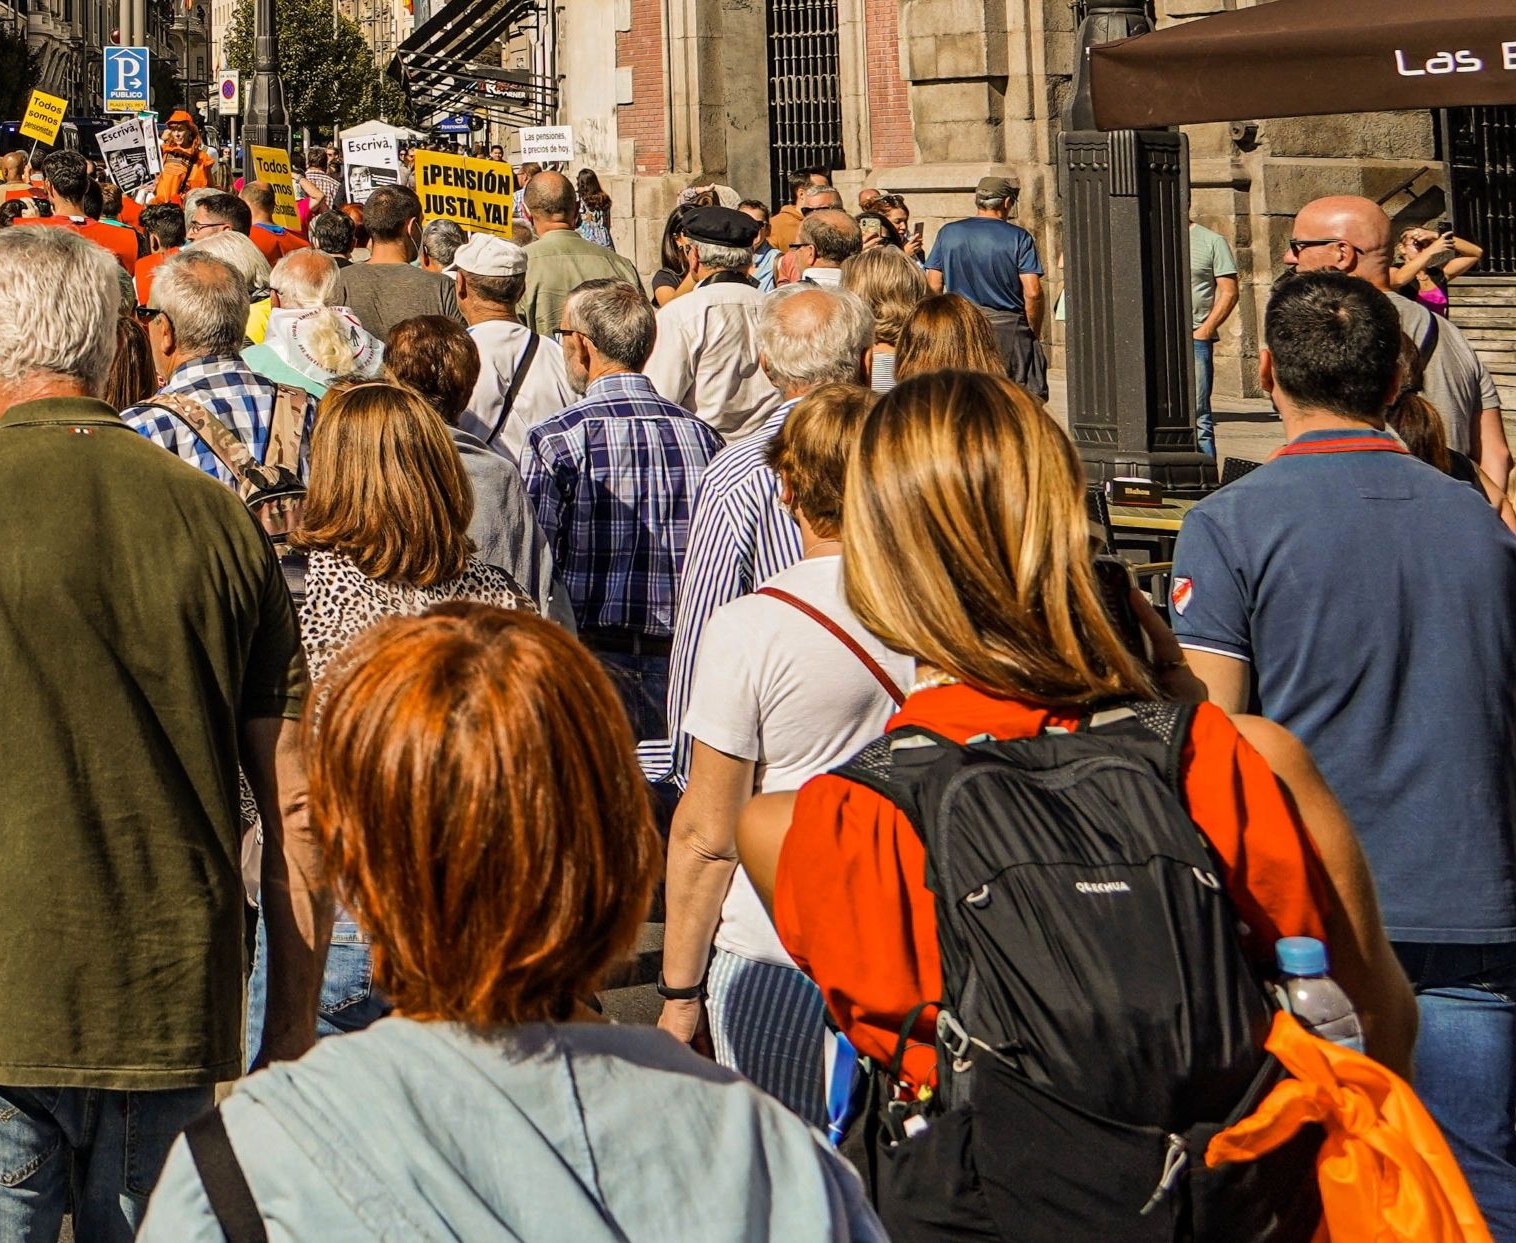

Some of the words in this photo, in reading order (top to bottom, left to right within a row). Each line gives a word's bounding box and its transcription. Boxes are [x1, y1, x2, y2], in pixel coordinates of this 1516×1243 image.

[1394, 49, 1483, 76] Las
[34, 97, 62, 114] Todos
[29, 110, 58, 126] somos
[524, 132, 534, 141] Las
[256, 157, 289, 174] Todos
[422, 164, 510, 196] ¡PENSIÓN
[424, 193, 481, 222] JUSTA,
[482, 201, 509, 226] YA!
